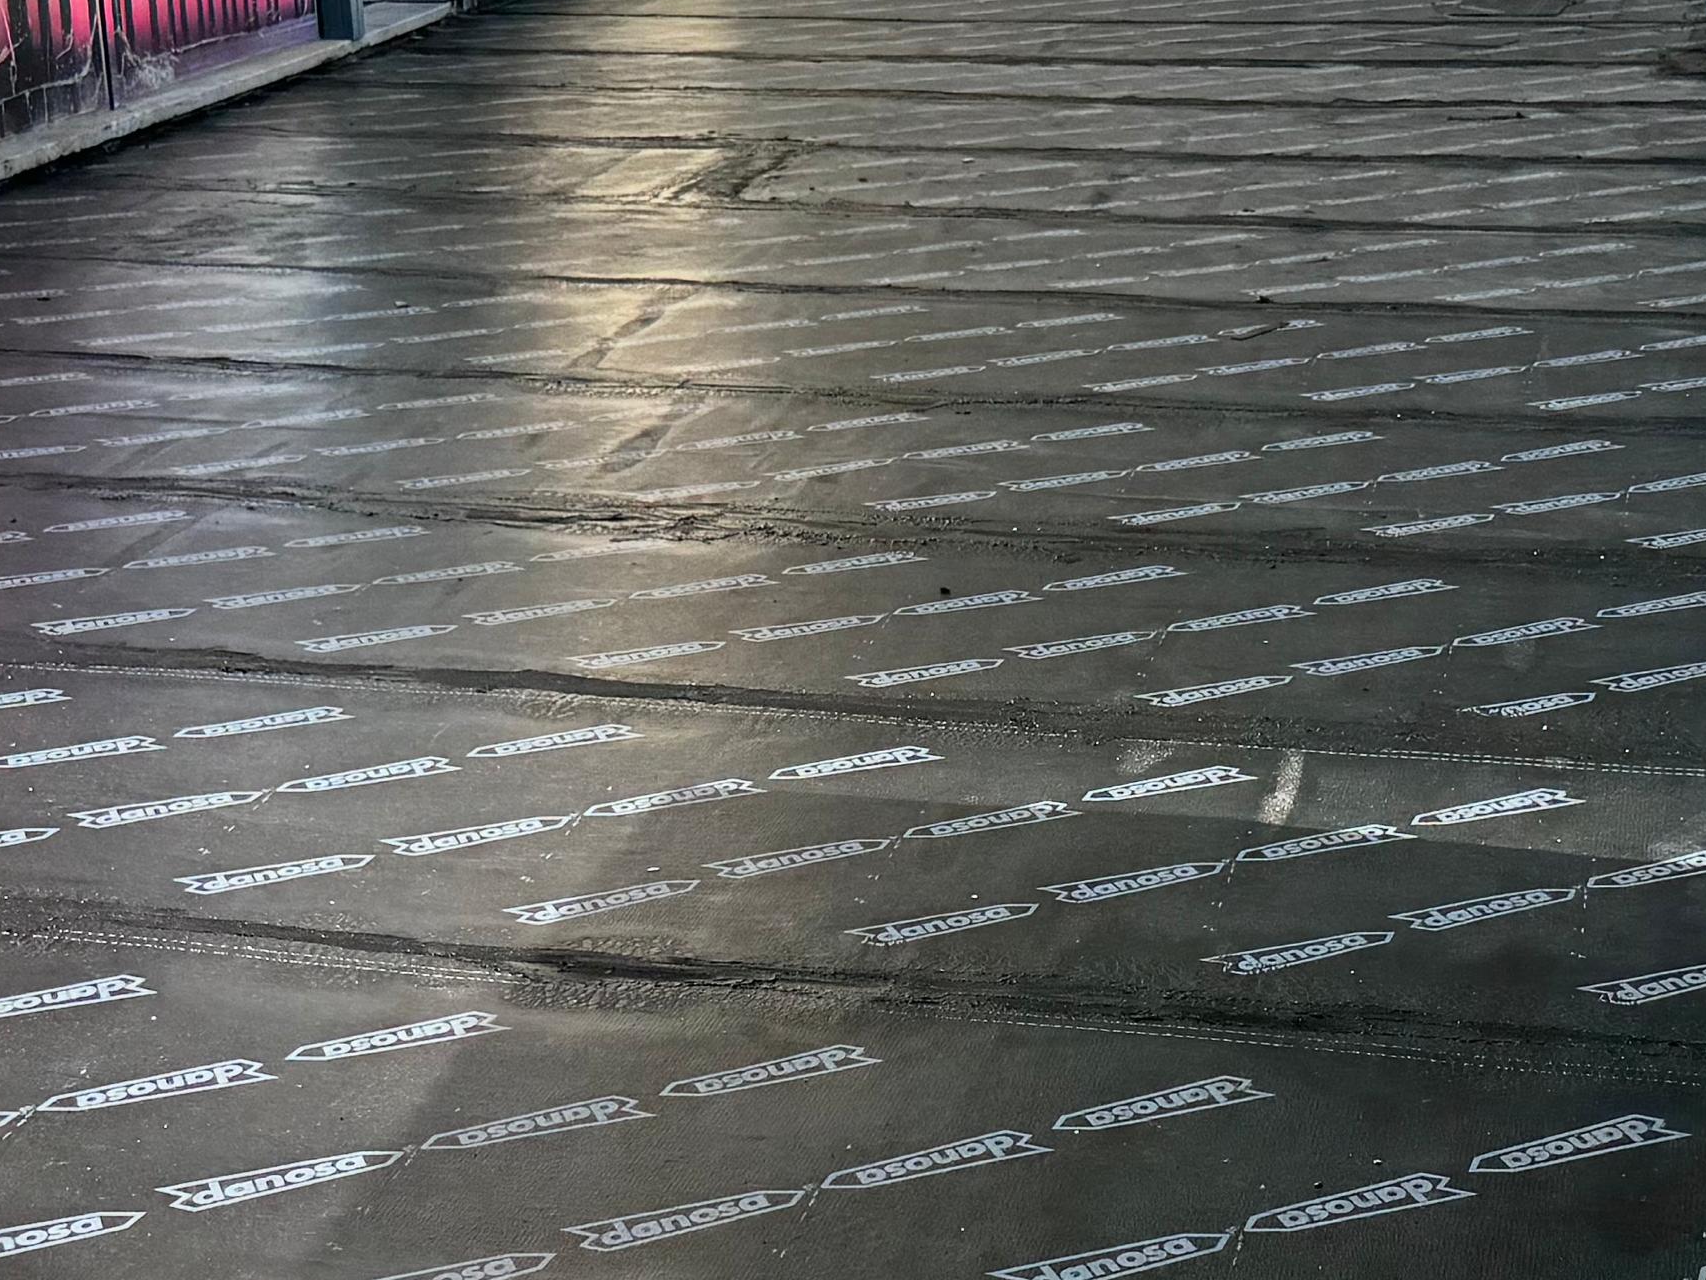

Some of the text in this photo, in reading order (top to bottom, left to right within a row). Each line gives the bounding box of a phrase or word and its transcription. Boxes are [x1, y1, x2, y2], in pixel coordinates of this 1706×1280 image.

[204, 856, 345, 892] danosa
[1071, 862, 1205, 900] danosa
[534, 883, 673, 922] danosa
[319, 1015, 481, 1058] danosa
[74, 1063, 249, 1108] danosa
[1084, 1080, 1238, 1131] danosa
[456, 1099, 624, 1147] danosa
[192, 1155, 367, 1208] danosa
[854, 1135, 1017, 1186] danosa
[1276, 1177, 1435, 1229] danosa
